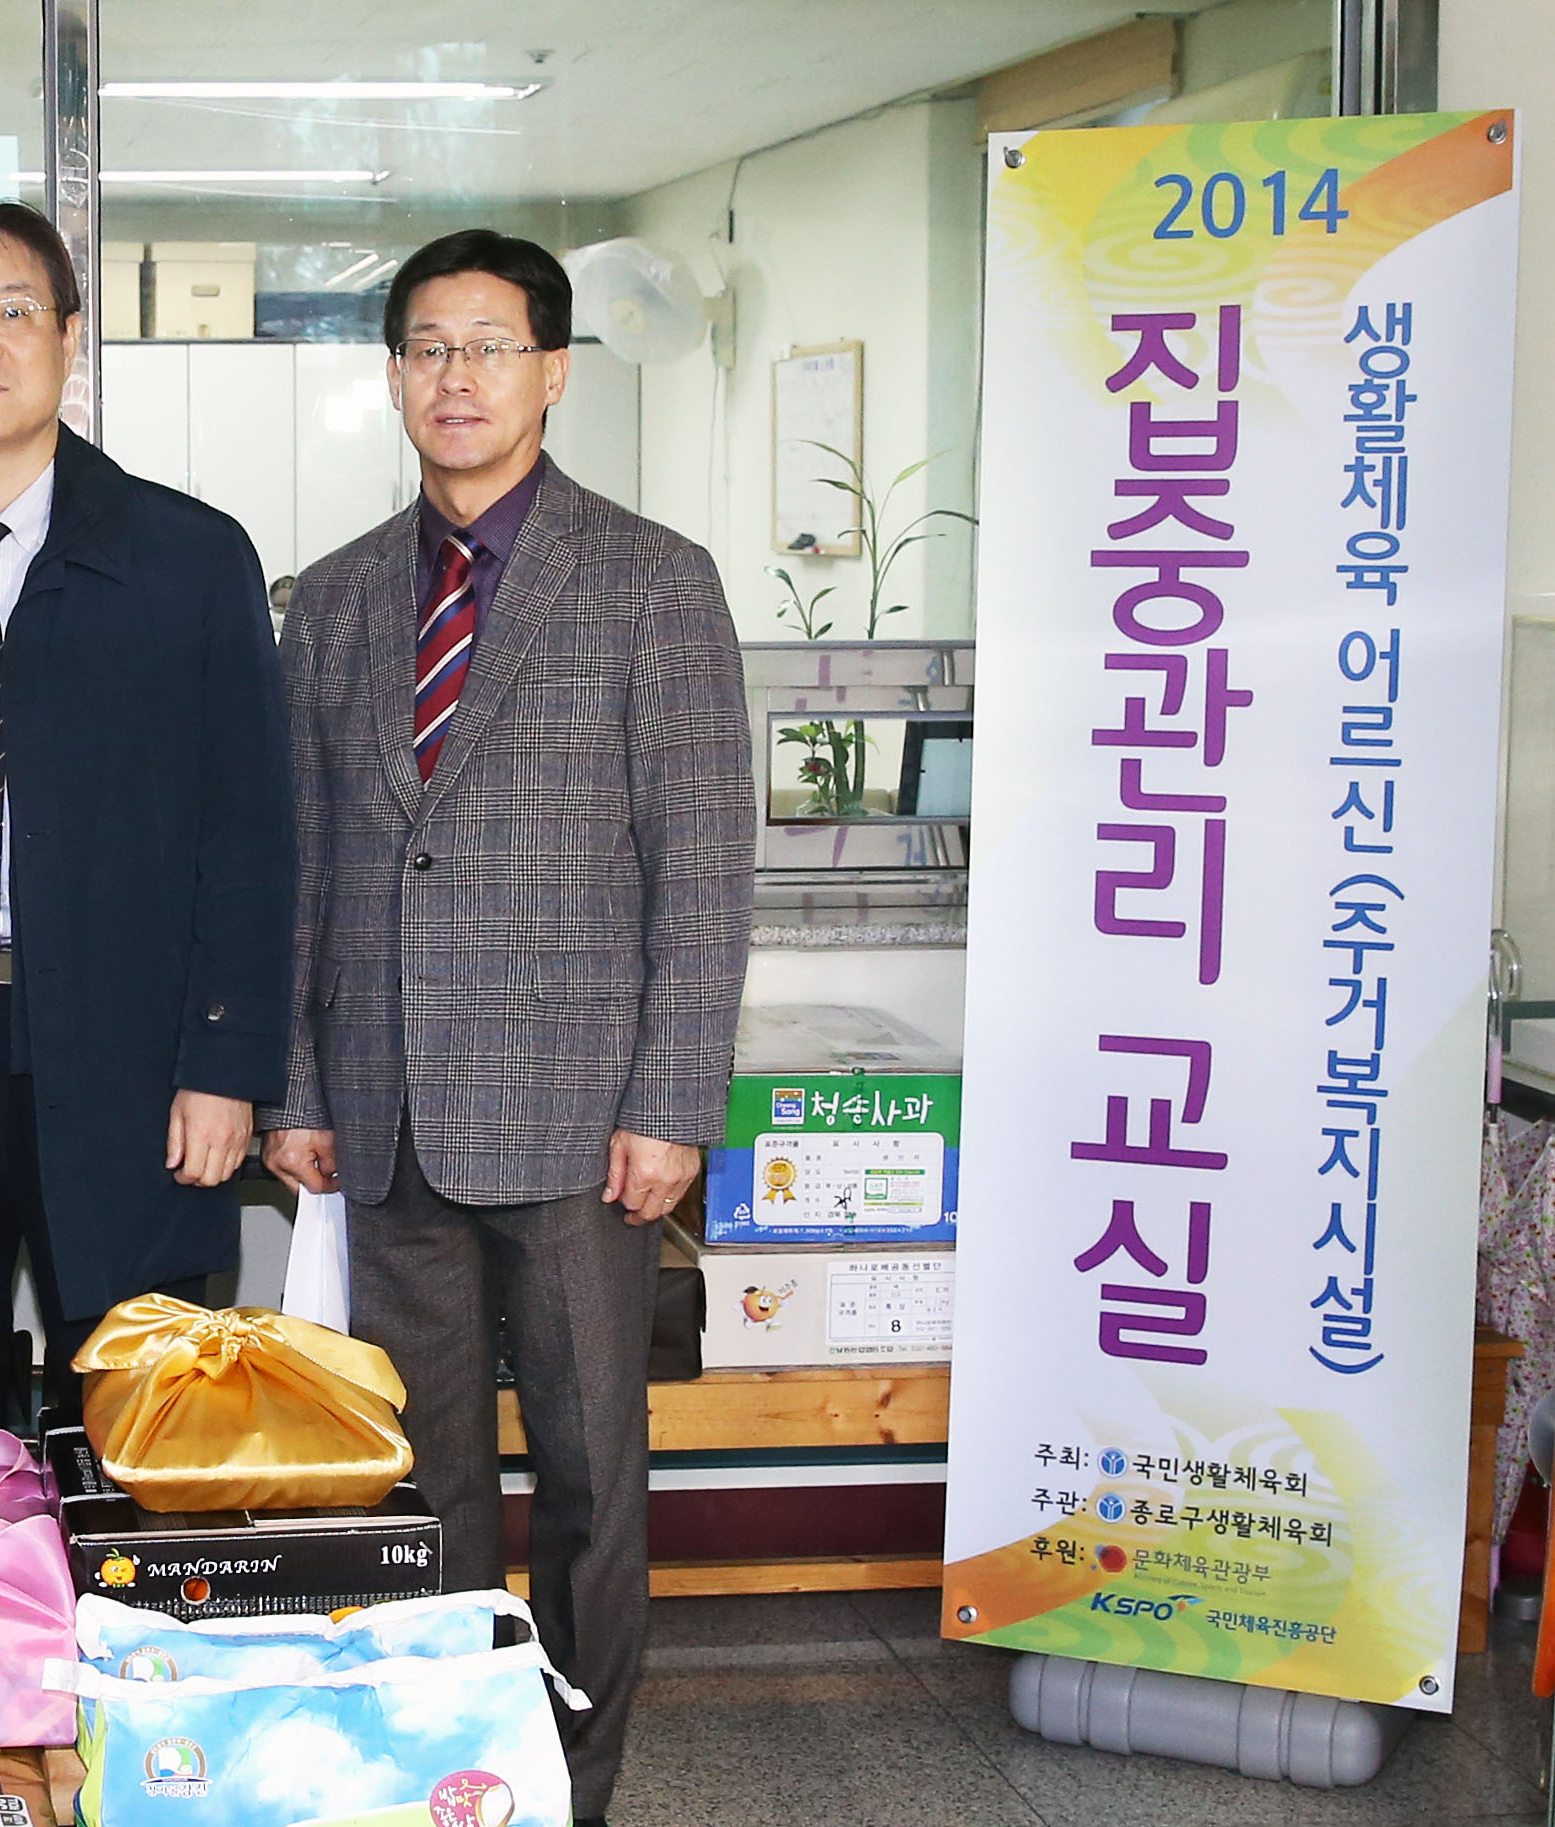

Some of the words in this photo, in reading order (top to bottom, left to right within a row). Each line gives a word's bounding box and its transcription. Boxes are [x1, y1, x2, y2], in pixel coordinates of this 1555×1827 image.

[1153, 168, 1349, 239] 2014
[1336, 302, 1417, 606] 생활체육
[1090, 304, 1253, 986] 집중관리
[1329, 628, 1402, 854] 어르신
[811, 1090, 934, 1126] 청송사과
[1309, 874, 1405, 1374] (주거복지시설)
[1071, 1034, 1228, 1366] 교실
[891, 1319, 902, 1333] 8
[1035, 1444, 1089, 1471] 주최:
[1132, 1454, 1308, 1497] 국민생활체육회
[1031, 1488, 1087, 1516] 주관:
[1130, 1500, 1333, 1547] 종로구생활체육회
[147, 1554, 282, 1578] MANDARIN
[380, 1544, 429, 1567] 10kg
[1030, 1537, 1085, 1565] 후원:
[1133, 1549, 1272, 1585] 문화체육관광부
[1090, 1592, 1174, 1621] KSPO
[1205, 1609, 1337, 1645] 국민체육진흥공단
